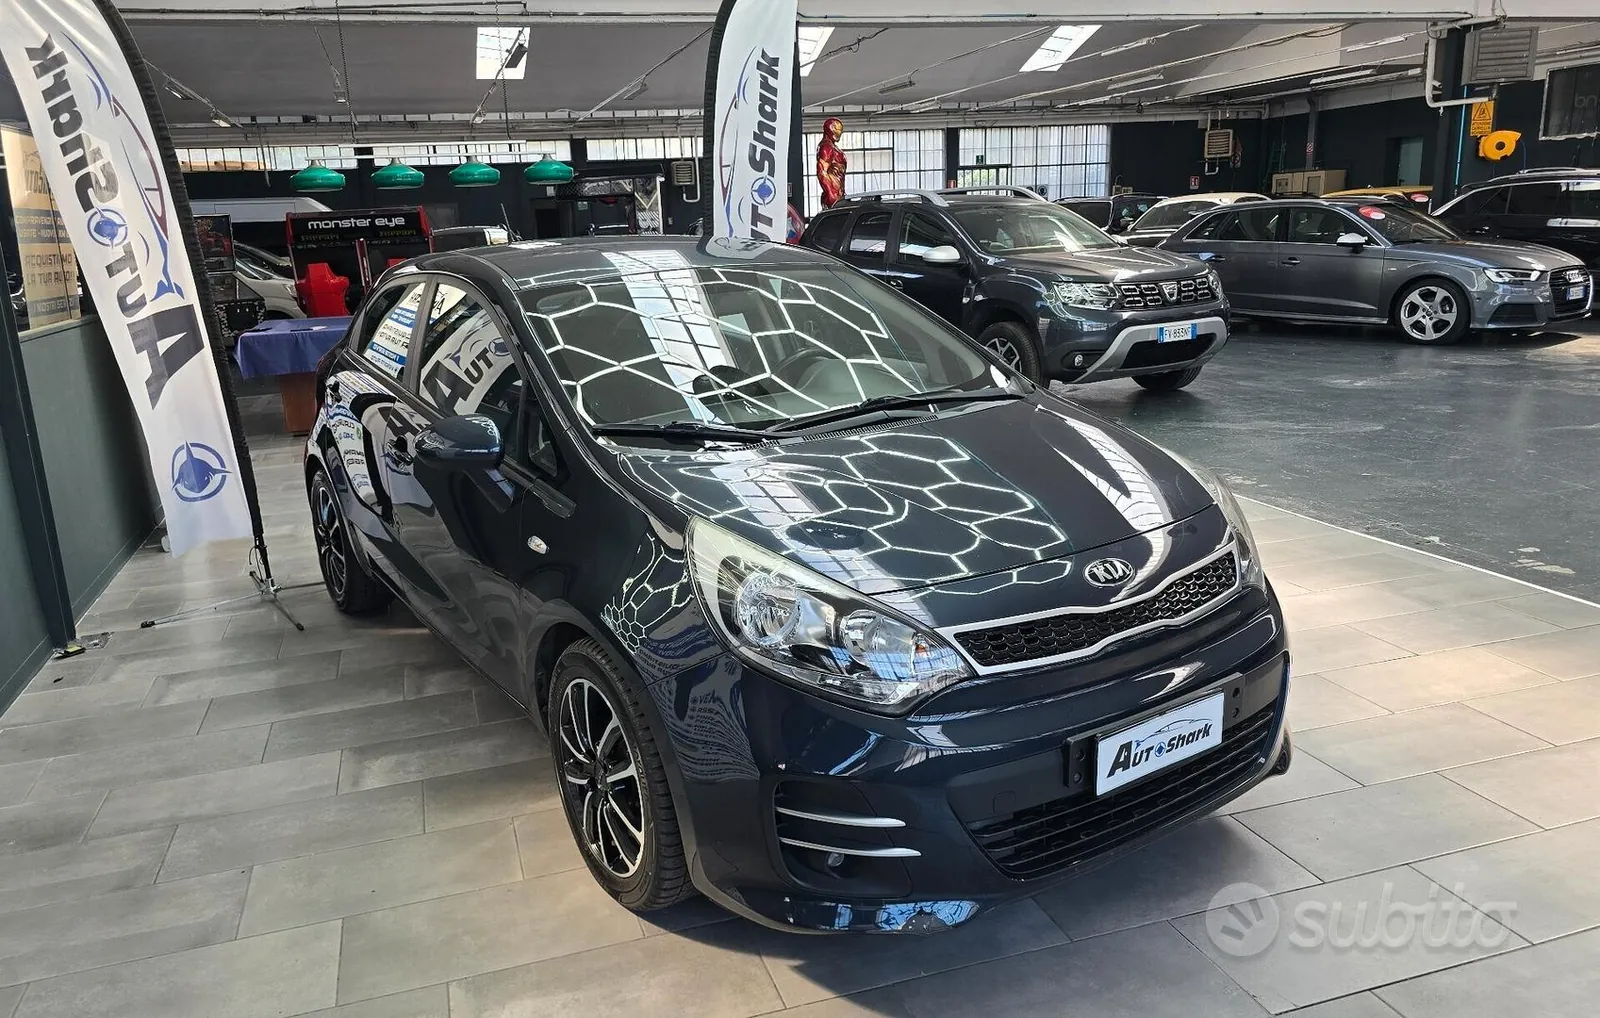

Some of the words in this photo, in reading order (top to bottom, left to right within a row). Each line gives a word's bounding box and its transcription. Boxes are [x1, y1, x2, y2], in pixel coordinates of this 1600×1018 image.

[308, 218, 371, 230] monster
[375, 217, 405, 228] eye
[1090, 560, 1131, 583] KIA
